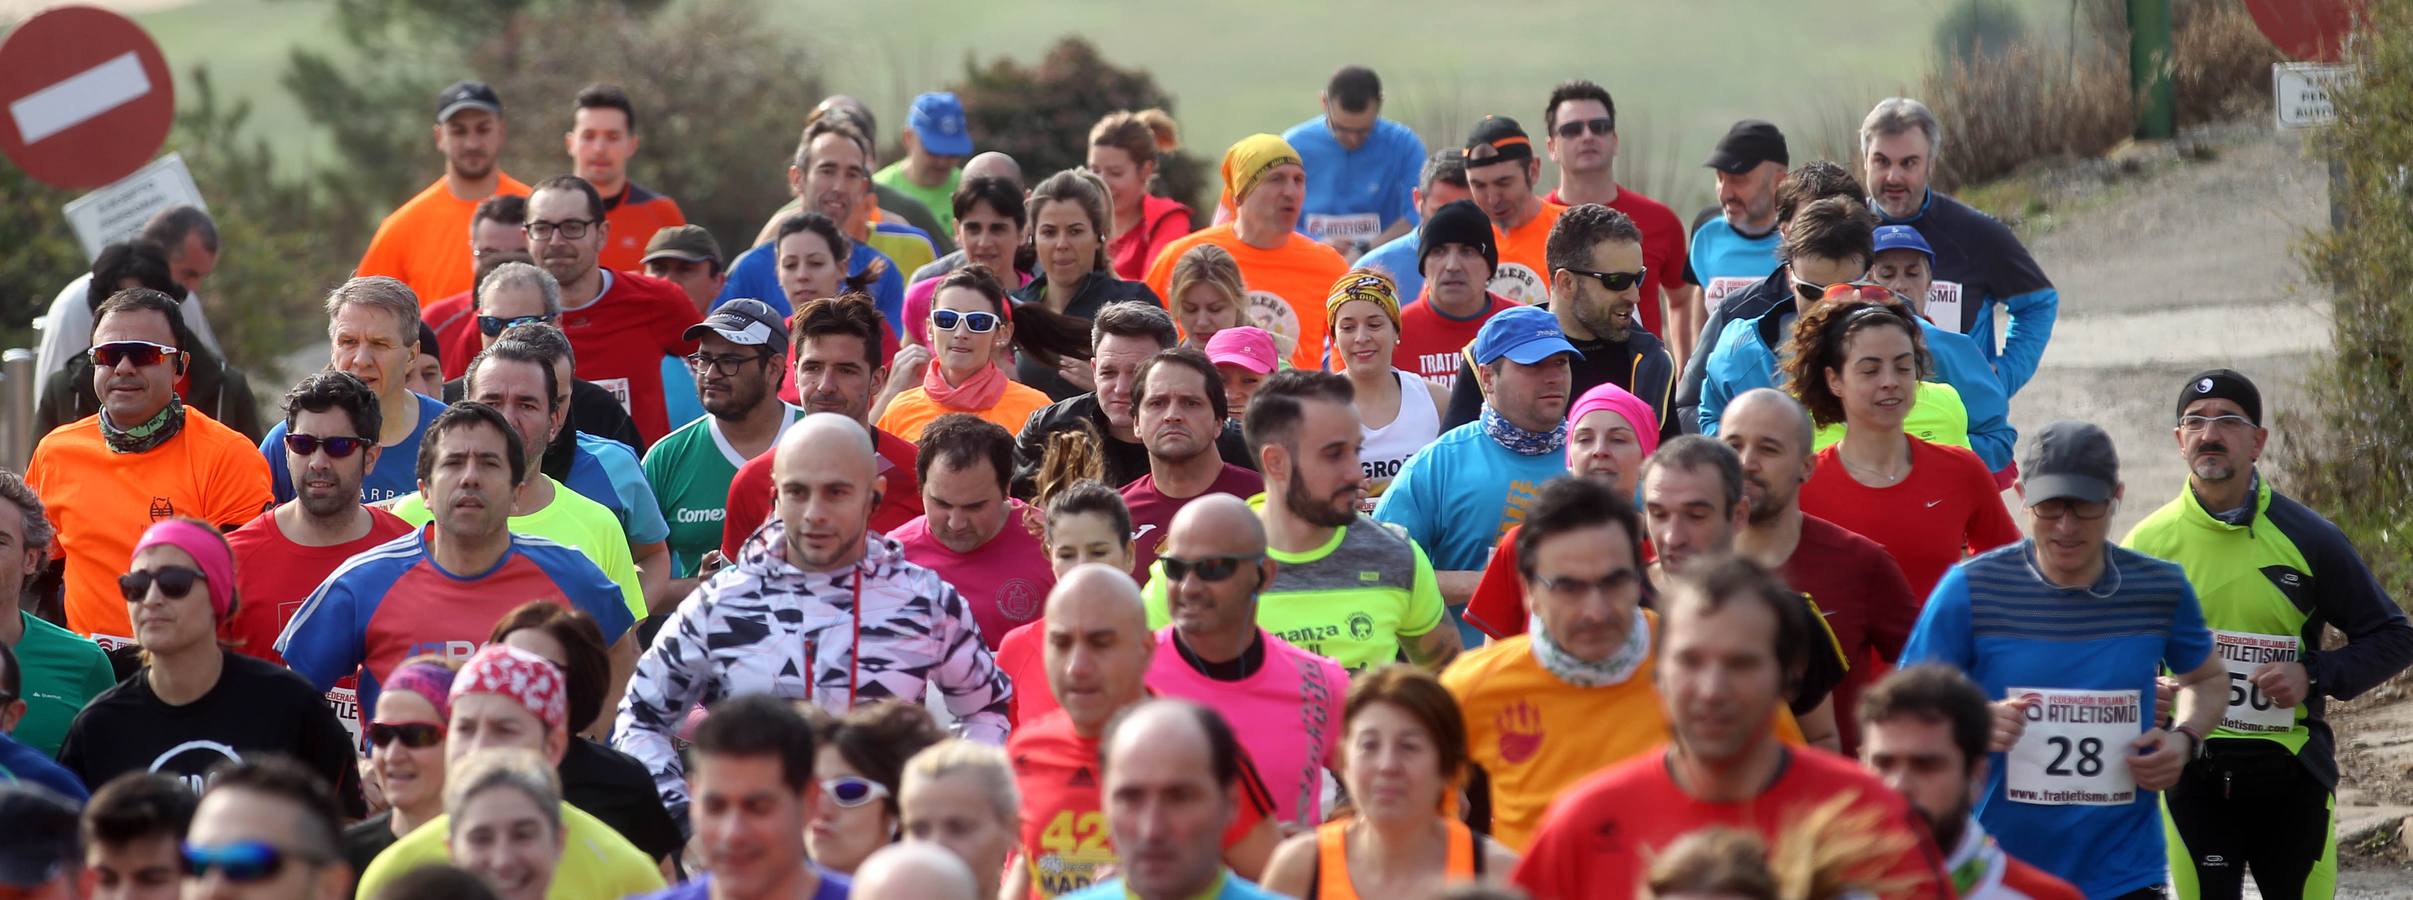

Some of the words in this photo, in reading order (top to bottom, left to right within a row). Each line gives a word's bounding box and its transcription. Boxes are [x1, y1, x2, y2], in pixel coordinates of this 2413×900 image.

[1419, 352, 1464, 374] TRATA
[1361, 454, 1413, 479] GRO
[2216, 642, 2296, 664] ATLETISMO
[2048, 704, 2138, 723] ATLETISMO
[2046, 736, 2104, 777] 28
[1042, 810, 1112, 862] 42
